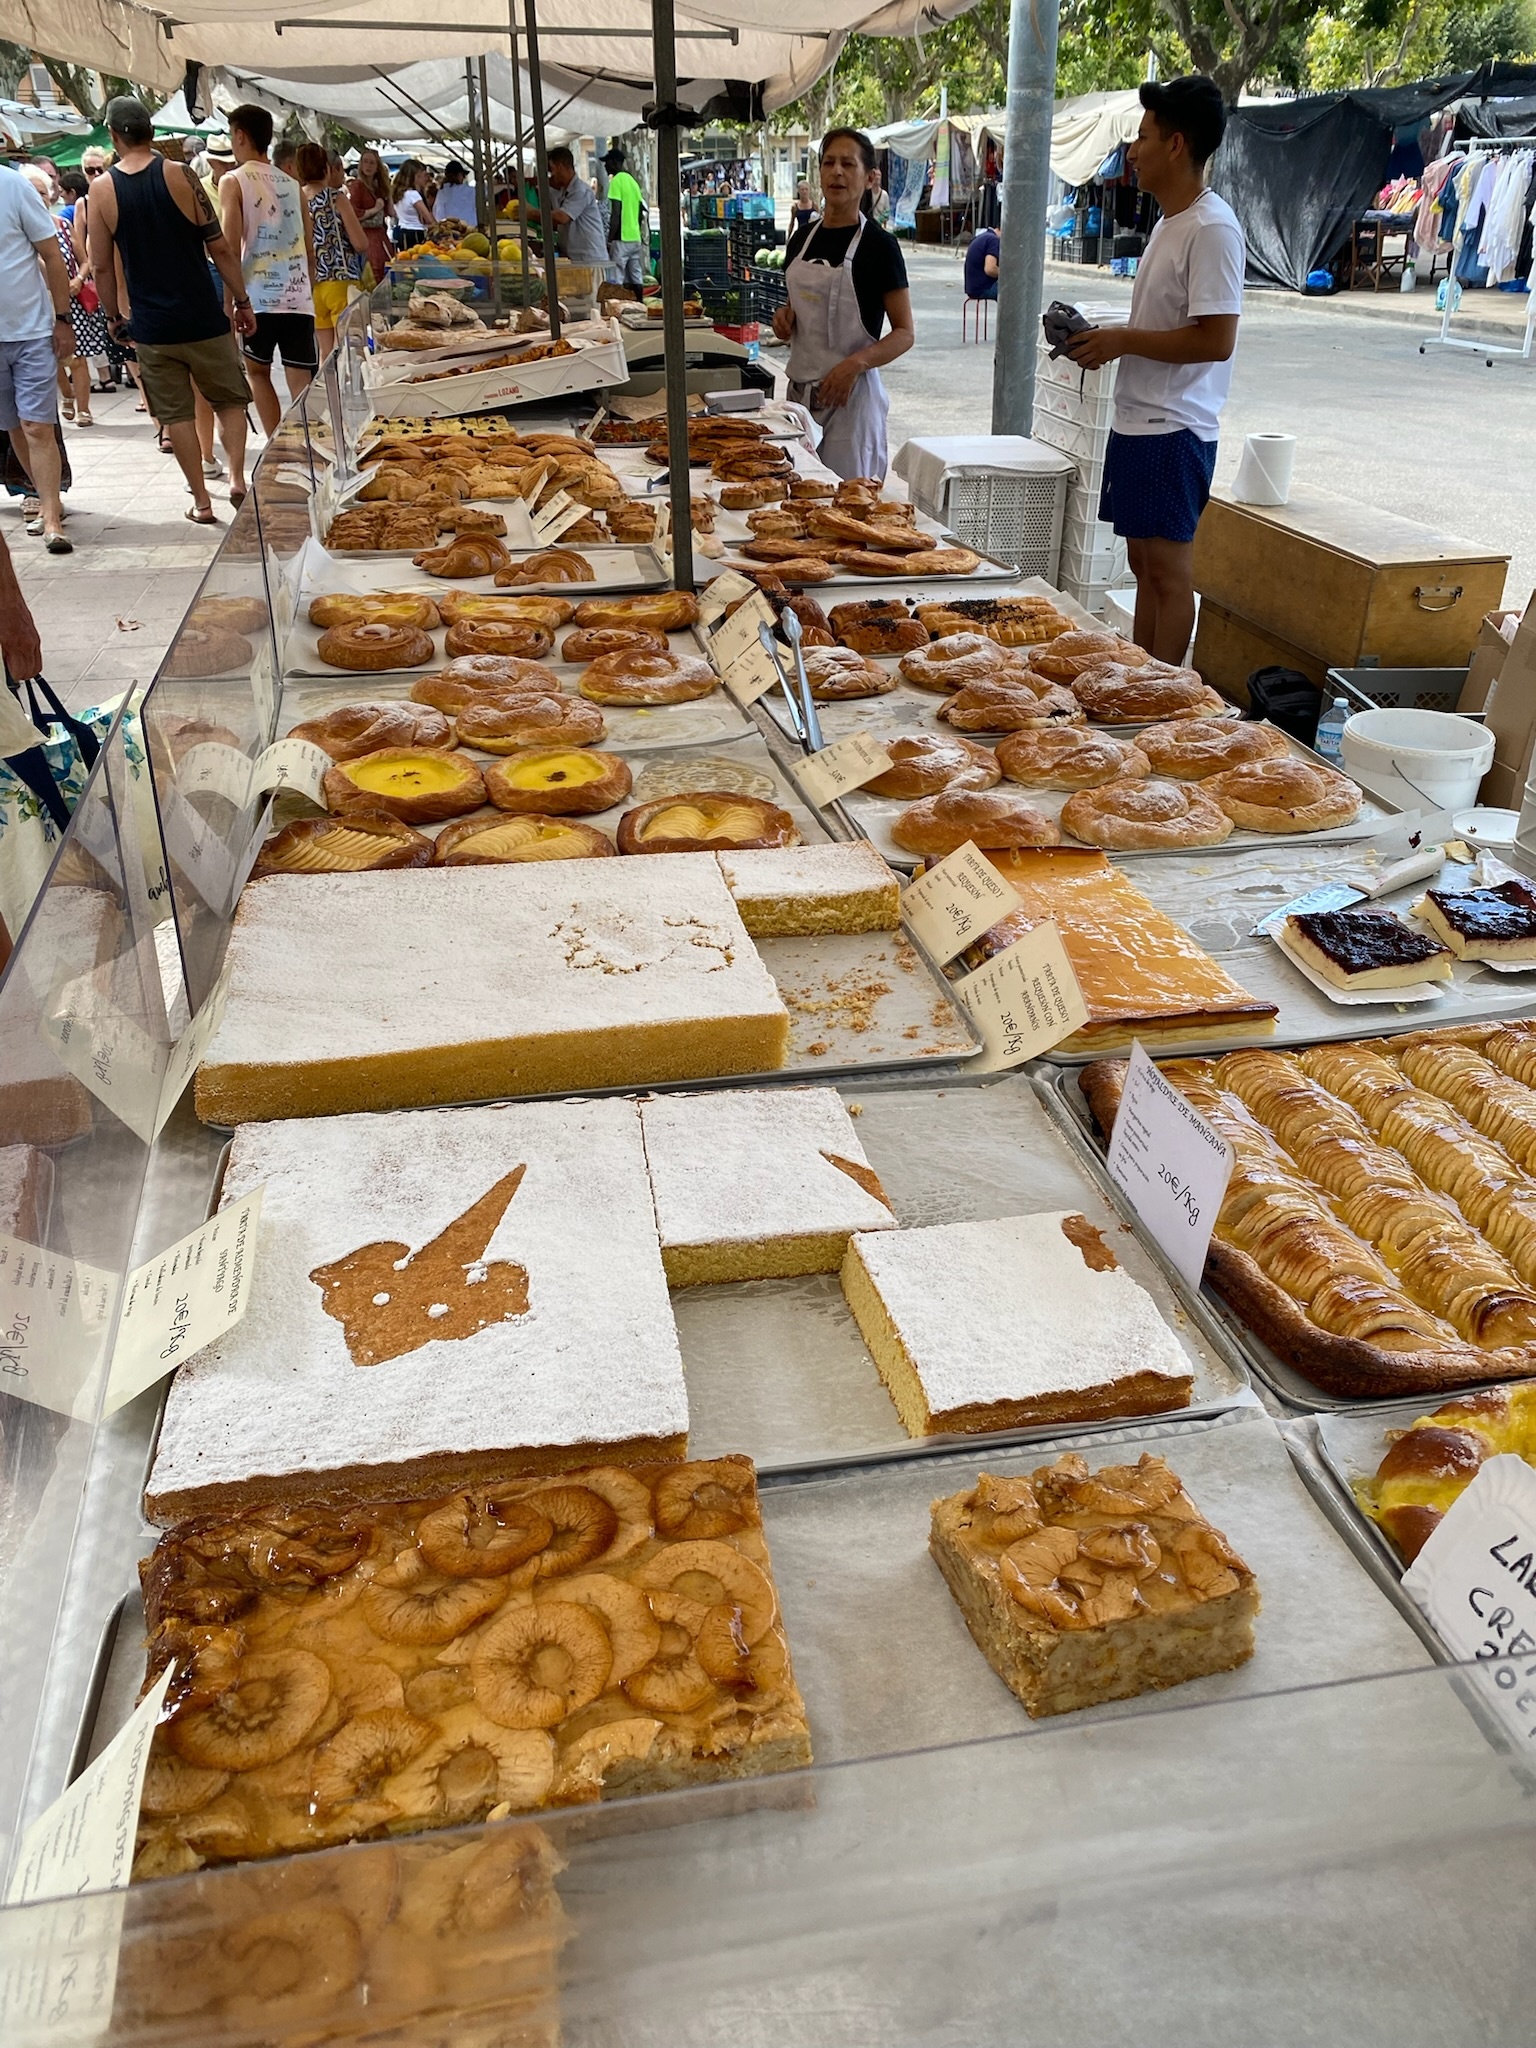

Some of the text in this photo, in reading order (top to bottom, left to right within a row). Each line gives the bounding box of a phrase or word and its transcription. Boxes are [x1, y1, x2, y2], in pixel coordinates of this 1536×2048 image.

[498, 385, 520, 397] LOZANO
[962, 853, 980, 871] TARTA
[975, 868, 987, 879] DE
[982, 876, 1000, 894] QUESO
[945, 903, 972, 936] 20€/Kg
[1042, 963, 1056, 987] TARTA
[1051, 986, 1060, 997] DE
[1044, 1012, 1057, 1027] CON
[1054, 996, 1068, 1018] QUESO
[1000, 1011, 1024, 1055] 20€/Kg
[1146, 1065, 1226, 1158] HOJALDRE DE MANZANA
[1157, 1163, 1200, 1227] 20€/Kg
[227, 1207, 250, 1316] TARTA DE ALMENDRA DE
[160, 1293, 190, 1359] 20€/Kg
[116, 1721, 148, 1829] PUDDING
[112, 1828, 127, 1868] DE
